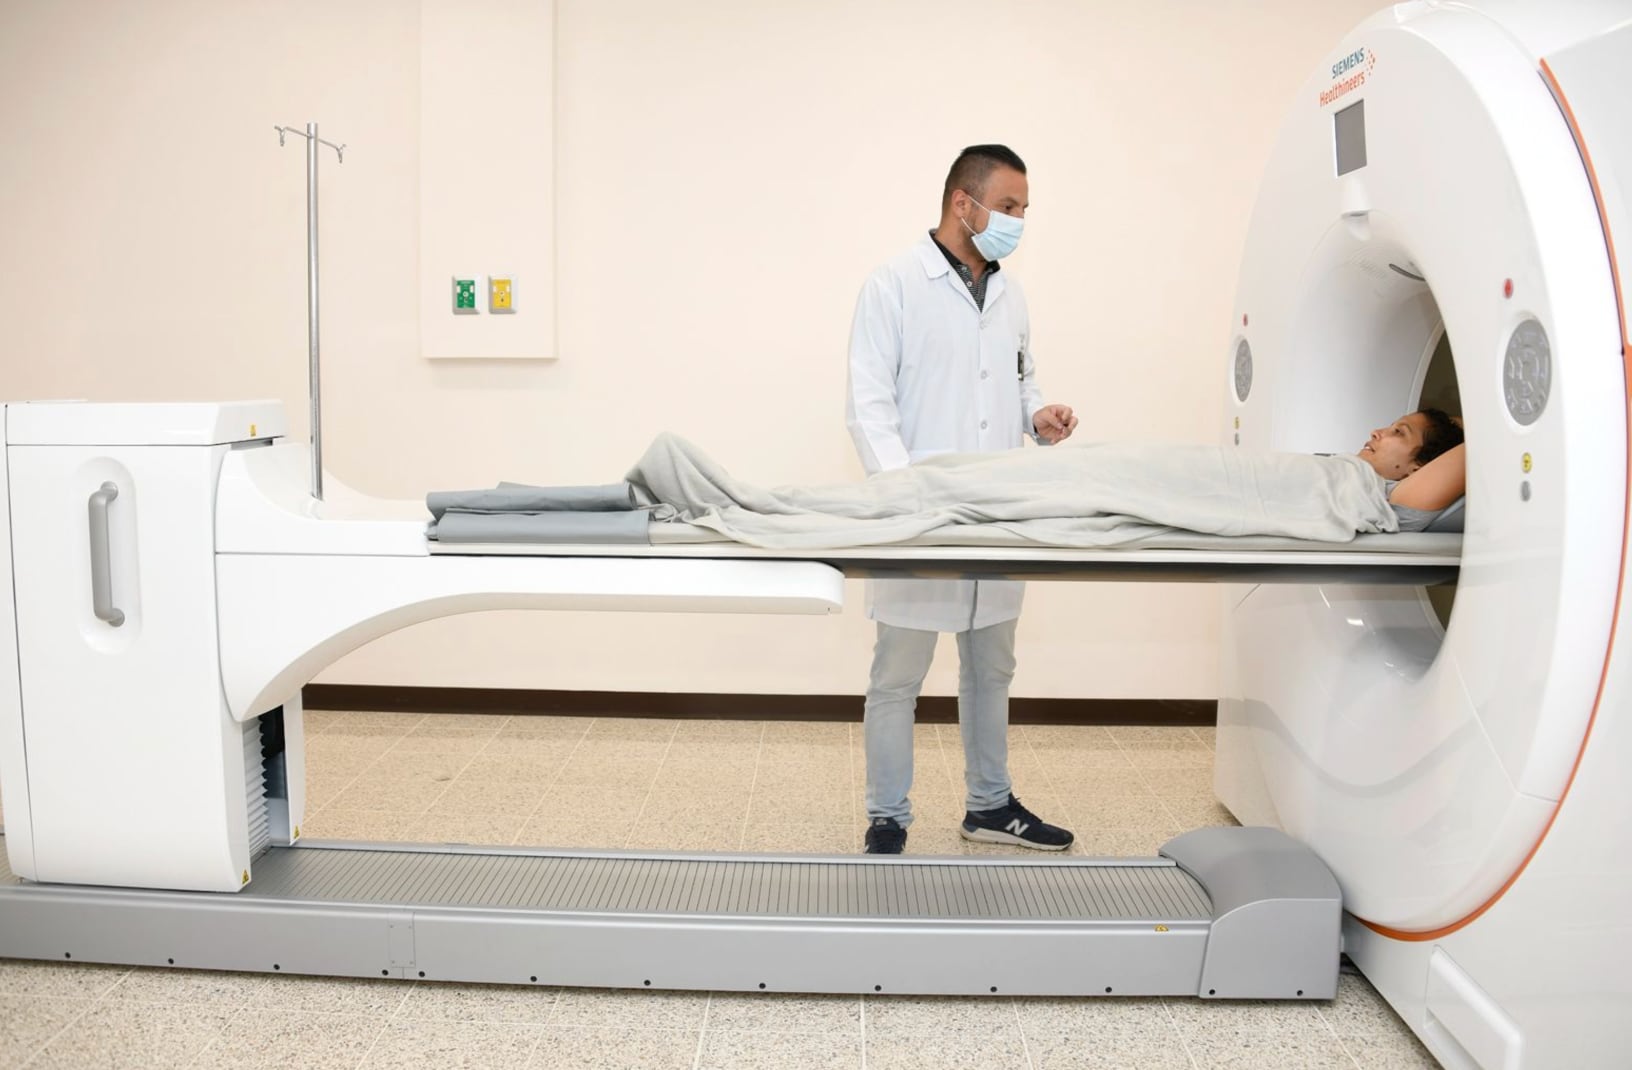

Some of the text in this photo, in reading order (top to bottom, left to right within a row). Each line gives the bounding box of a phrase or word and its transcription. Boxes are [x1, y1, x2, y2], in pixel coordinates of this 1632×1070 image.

[1332, 47, 1364, 79] SIEMENS
[1319, 71, 1365, 107] Healthineers
[1004, 818, 1029, 836] N
